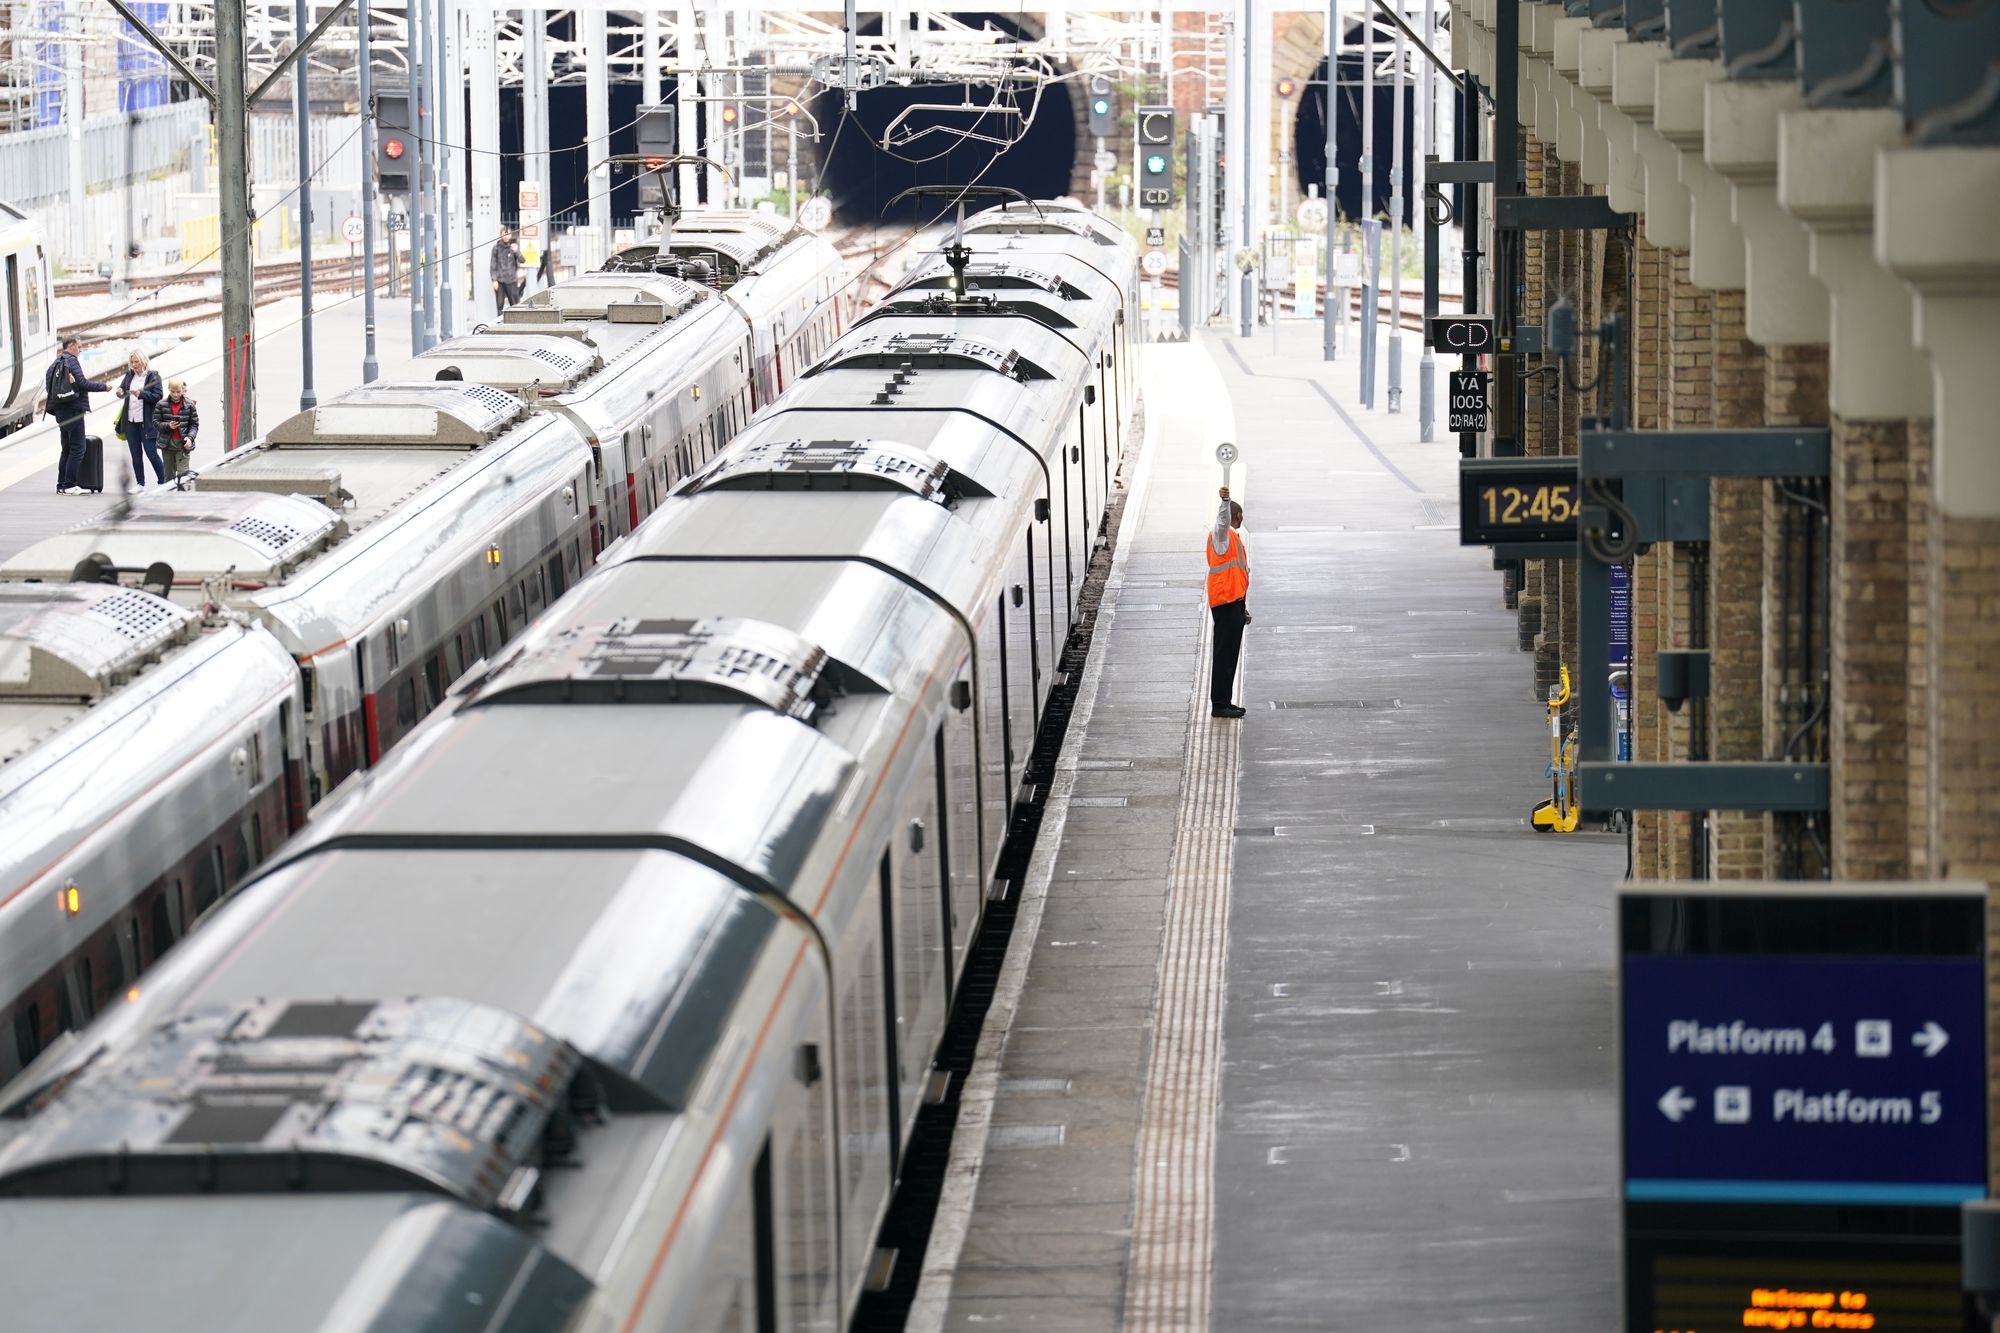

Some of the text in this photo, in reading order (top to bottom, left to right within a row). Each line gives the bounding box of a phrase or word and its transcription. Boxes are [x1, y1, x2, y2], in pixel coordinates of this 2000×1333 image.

[1142, 111, 1168, 142] C
[1146, 189, 1169, 204] CD
[348, 223, 362, 235] 25
[1148, 257, 1162, 269] 25
[1446, 323, 1488, 346] CD
[1458, 377, 1479, 390] YA
[1453, 395, 1484, 409] 1005
[1668, 1019, 1836, 1055] Platform 4
[1773, 1088, 1942, 1124] Platform 5
[1839, 1291, 1867, 1309] to
